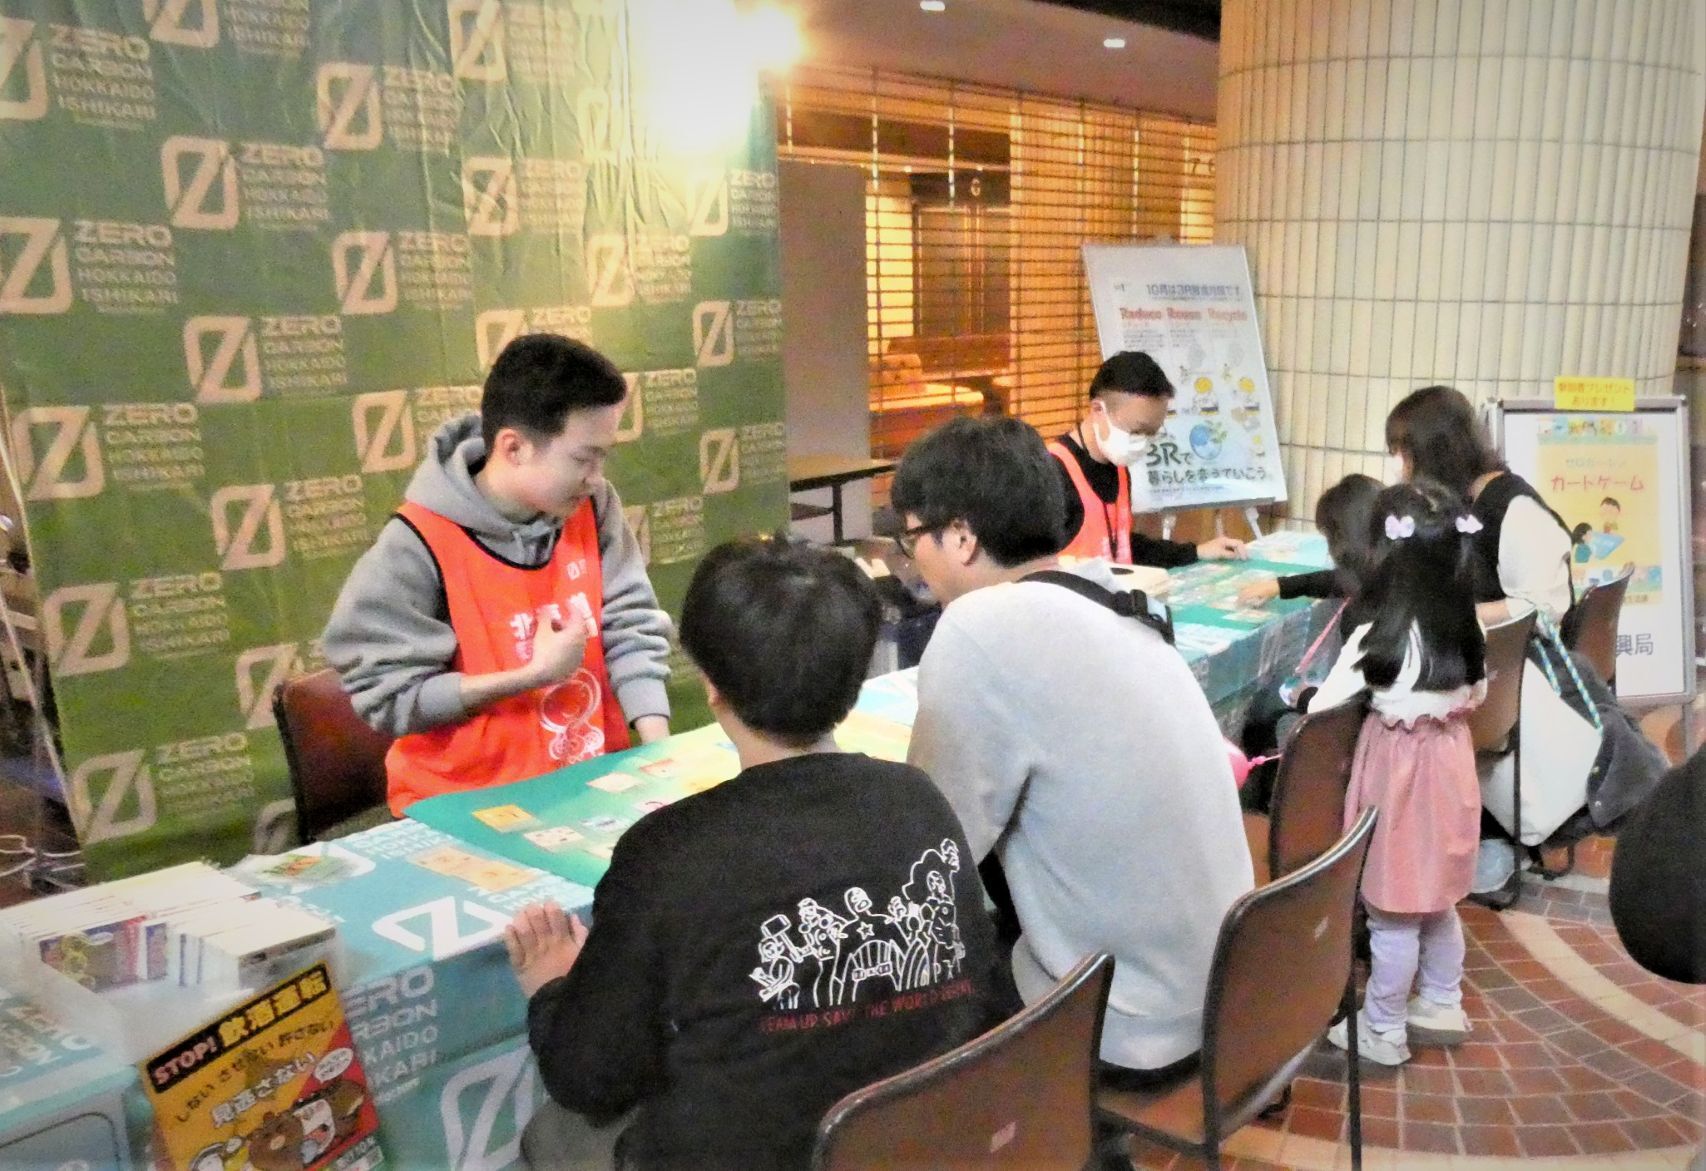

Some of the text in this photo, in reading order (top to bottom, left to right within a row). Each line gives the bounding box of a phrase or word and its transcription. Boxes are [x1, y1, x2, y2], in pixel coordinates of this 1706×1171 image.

[47, 24, 150, 60] ZERO
[240, 143, 324, 166] ZERO
[521, 158, 582, 179] ZERO
[730, 169, 776, 190] ZERO
[74, 220, 172, 247] ZERO
[398, 231, 468, 254] ZERO
[75, 248, 174, 266] CARBON
[261, 315, 341, 336] ZERO
[531, 306, 592, 325] ZERO
[645, 369, 697, 388] ZERO
[415, 386, 481, 406] ZERO
[102, 403, 198, 426] ZERO
[104, 429, 201, 445] CARBON
[284, 474, 363, 502] ZERO
[129, 573, 222, 599] ZERO
[156, 732, 247, 764] ZERO
[343, 966, 434, 1018] ERO
[154, 1037, 218, 1085] STOP!
[219, 969, 328, 1047] 飲酒運転
[360, 1025, 438, 1063] KAIDO
